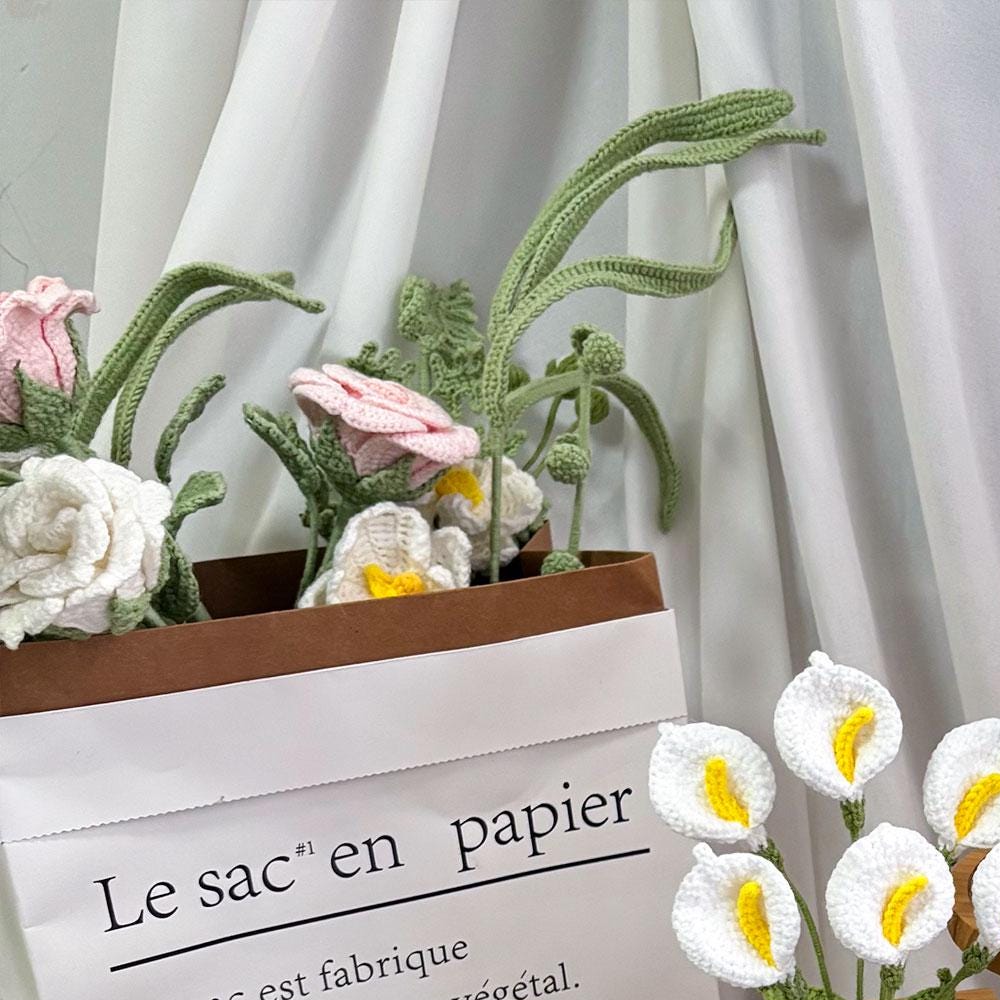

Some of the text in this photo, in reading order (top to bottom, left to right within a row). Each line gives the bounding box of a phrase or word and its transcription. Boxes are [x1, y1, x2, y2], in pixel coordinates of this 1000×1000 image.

[93, 875, 178, 933] Le
[198, 855, 296, 908] sac
[330, 834, 405, 879] en
[450, 781, 632, 873] papier
[319, 940, 469, 993] fabrique
